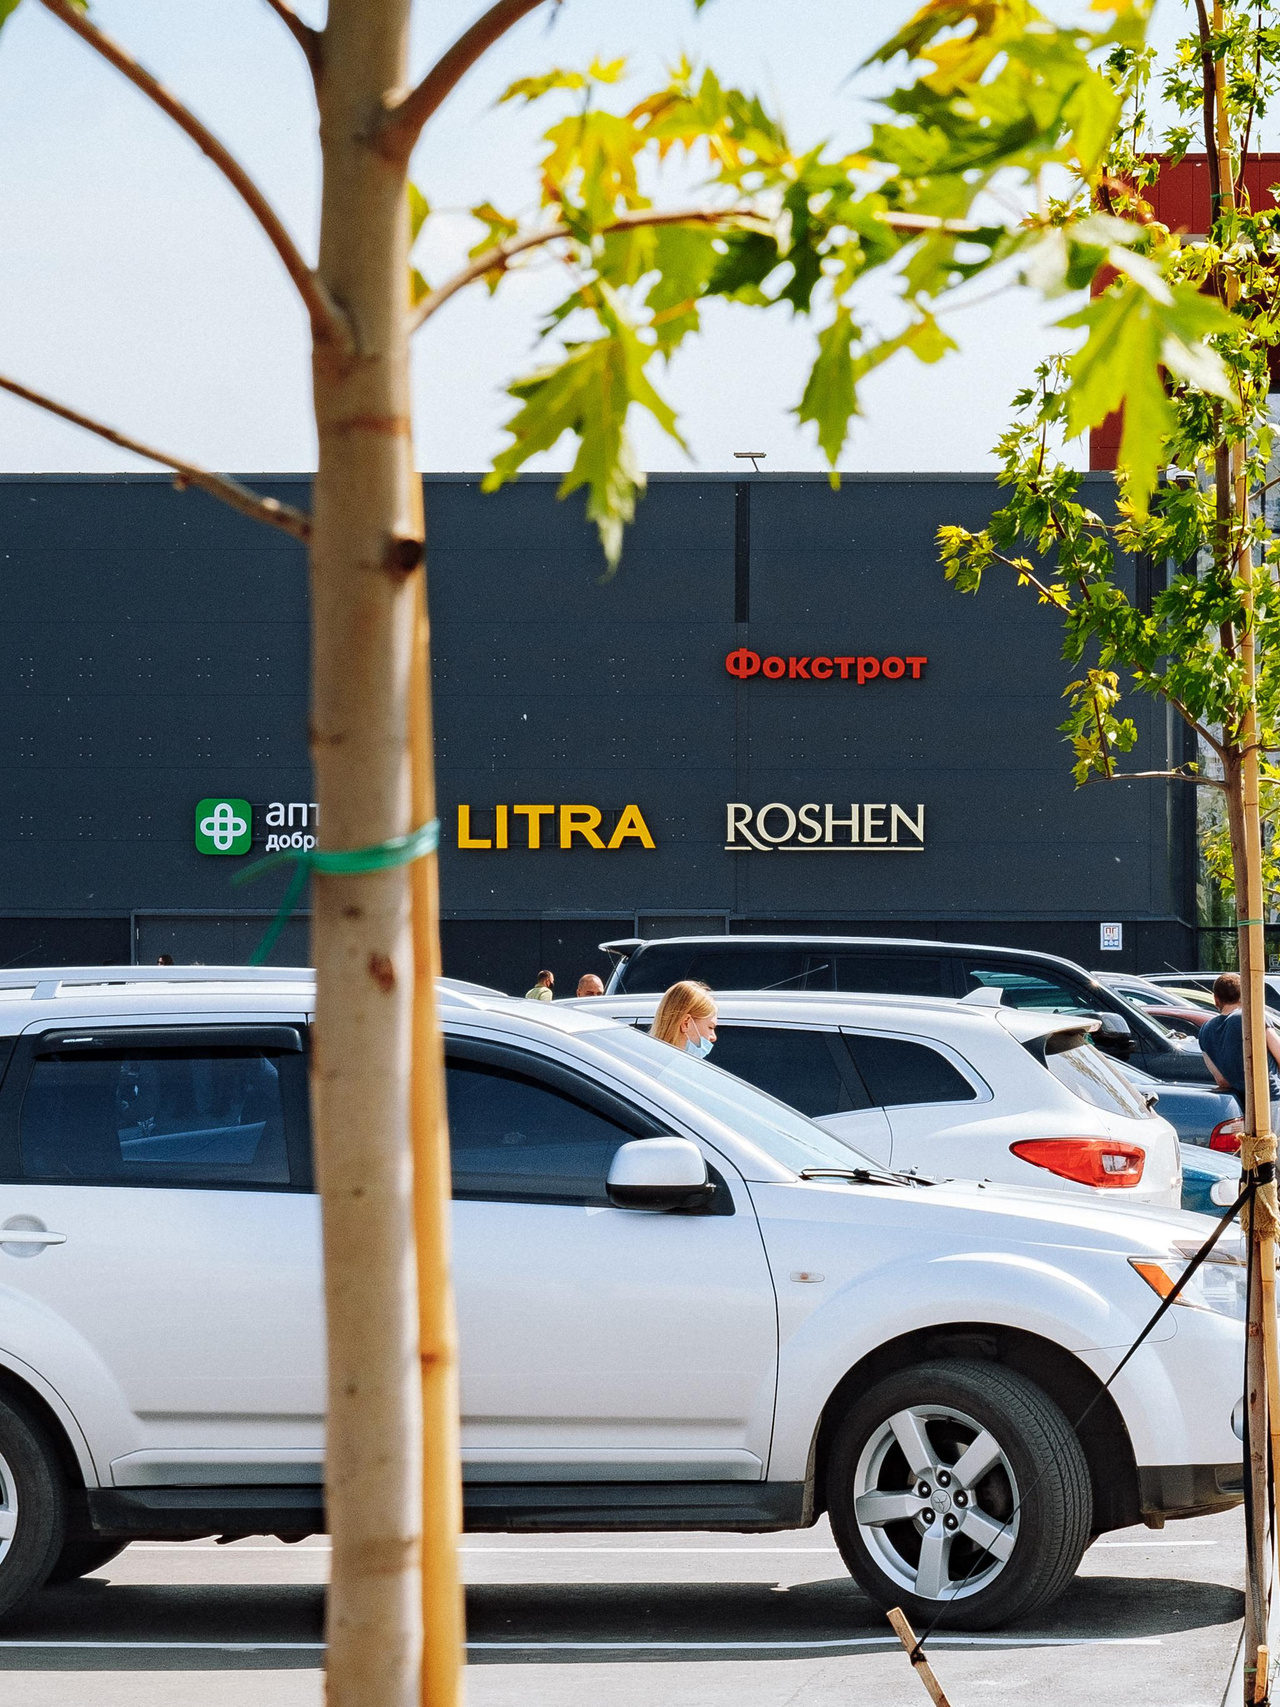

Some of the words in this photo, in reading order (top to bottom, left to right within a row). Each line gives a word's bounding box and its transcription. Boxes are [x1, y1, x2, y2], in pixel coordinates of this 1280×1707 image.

[725, 647, 928, 685] Фокстрот
[457, 804, 657, 849] LITRA
[725, 802, 925, 851] ROSHEN
